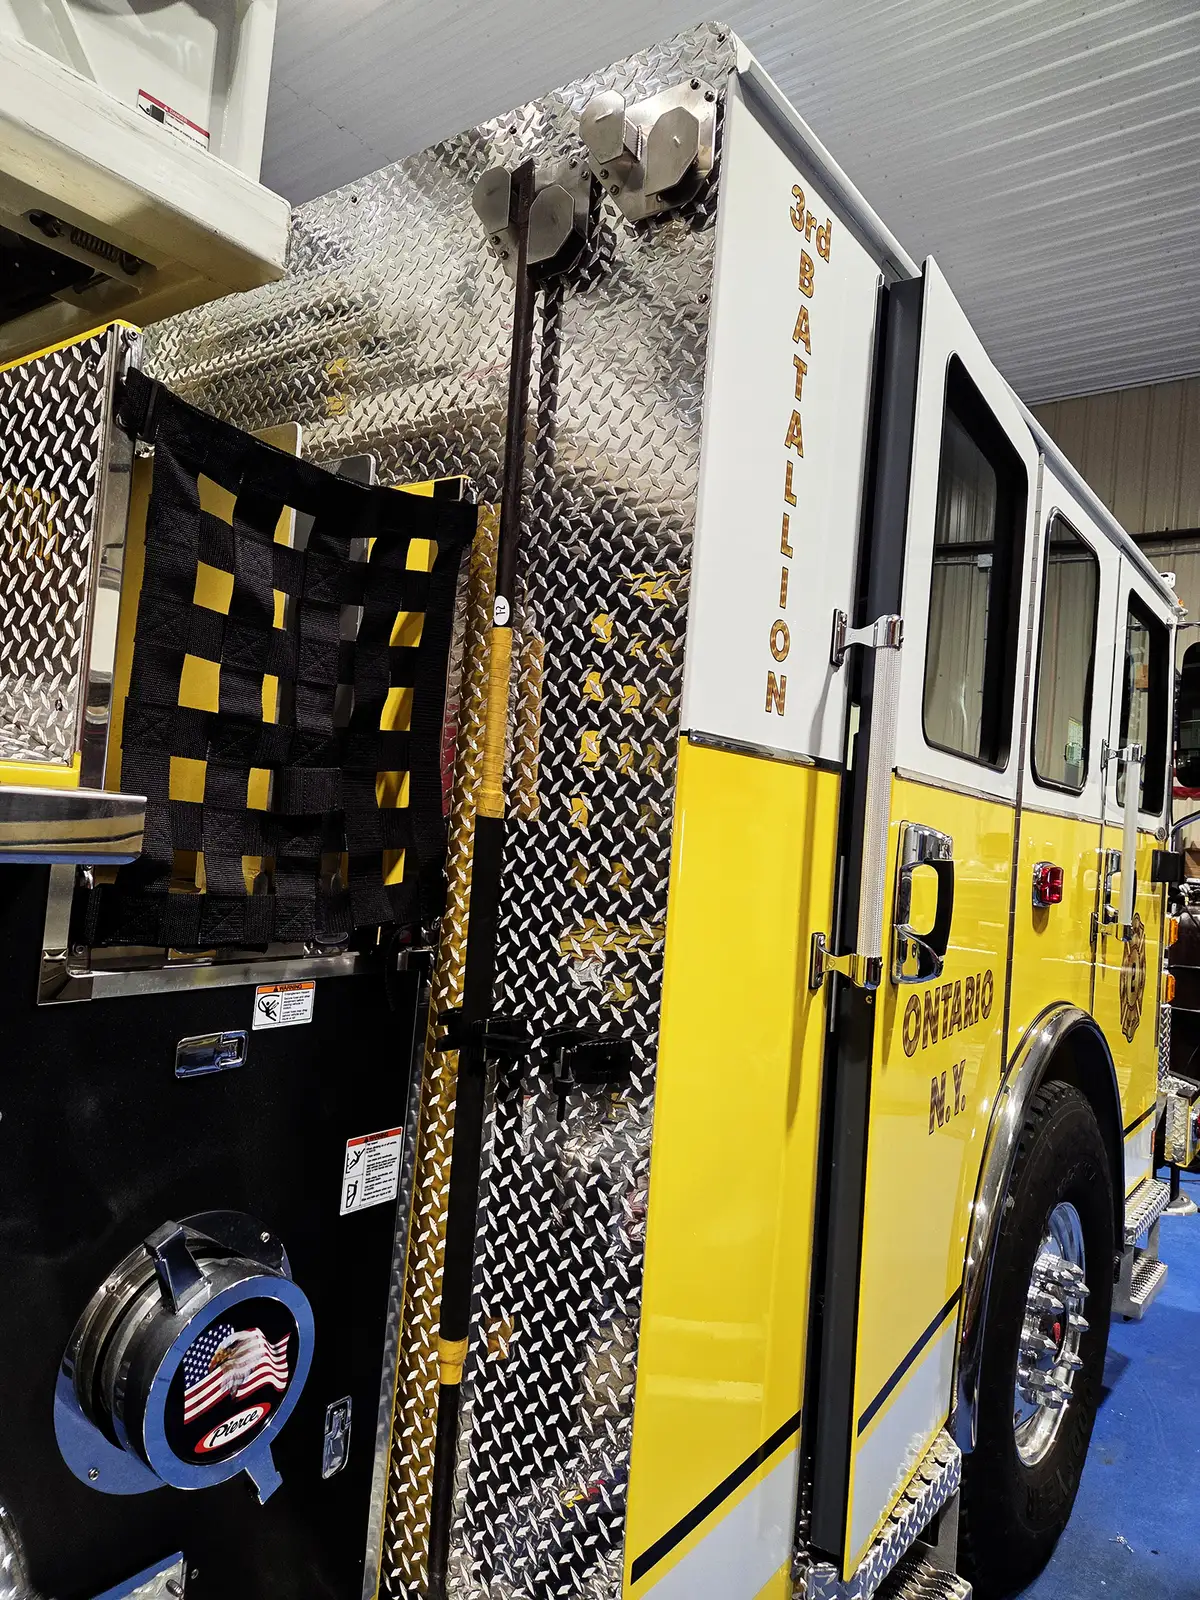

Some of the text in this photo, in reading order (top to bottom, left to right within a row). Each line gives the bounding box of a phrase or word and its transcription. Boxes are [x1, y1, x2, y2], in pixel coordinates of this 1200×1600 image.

[790, 183, 833, 264] 3rd
[766, 249, 815, 717] BATALLION
[280, 983, 303, 992] WARNING
[903, 969, 993, 1058] ONTARIO
[929, 1059, 967, 1135] N.Y.
[208, 1409, 258, 1448] Pierce
